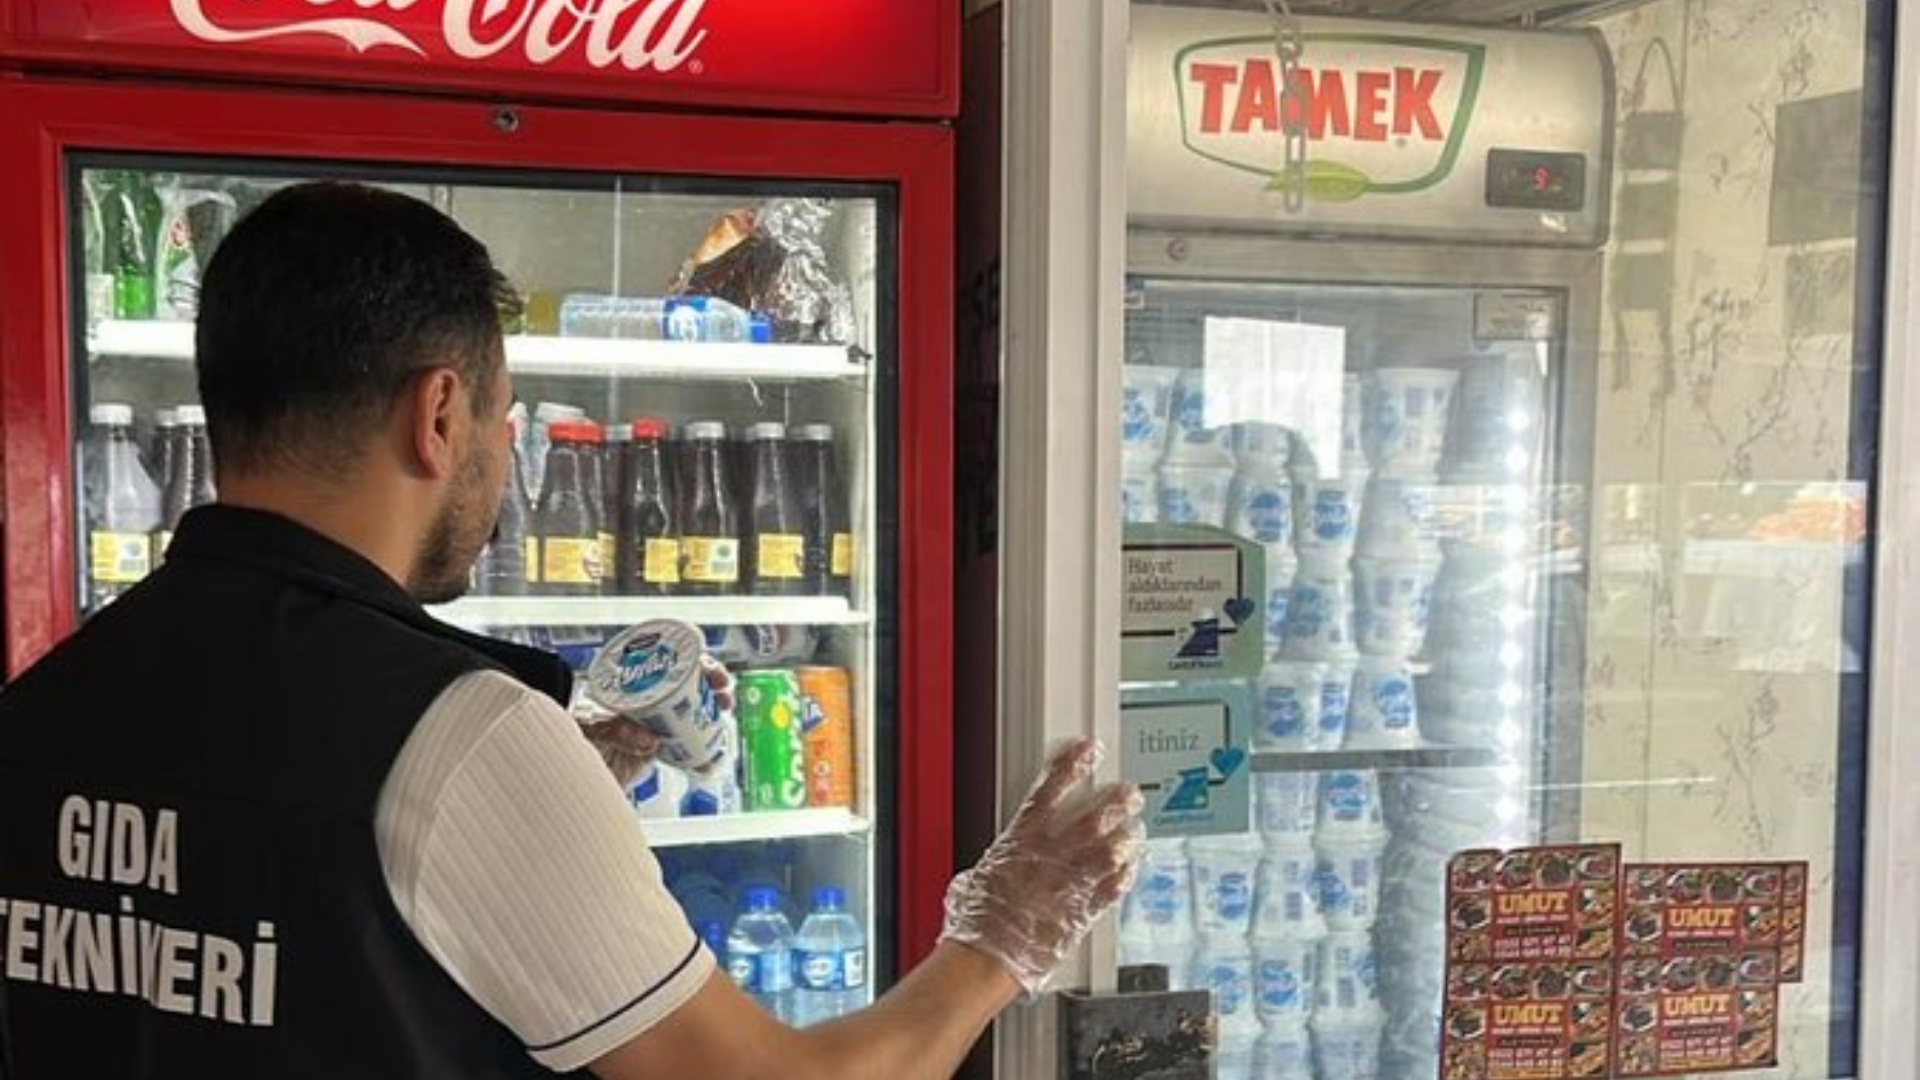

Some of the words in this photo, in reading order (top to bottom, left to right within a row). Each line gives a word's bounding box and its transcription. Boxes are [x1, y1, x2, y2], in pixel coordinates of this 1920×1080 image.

[1190, 58, 1444, 142] TAMEK
[1128, 557, 1174, 577] Hayat
[58, 794, 179, 895] GIDA
[1498, 891, 1569, 916] UMUT
[1668, 907, 1736, 928] UMUT
[0, 894, 278, 1027] EKNİERİ
[1494, 1004, 1563, 1027] UMUT
[1663, 993, 1731, 1017] UMUT
